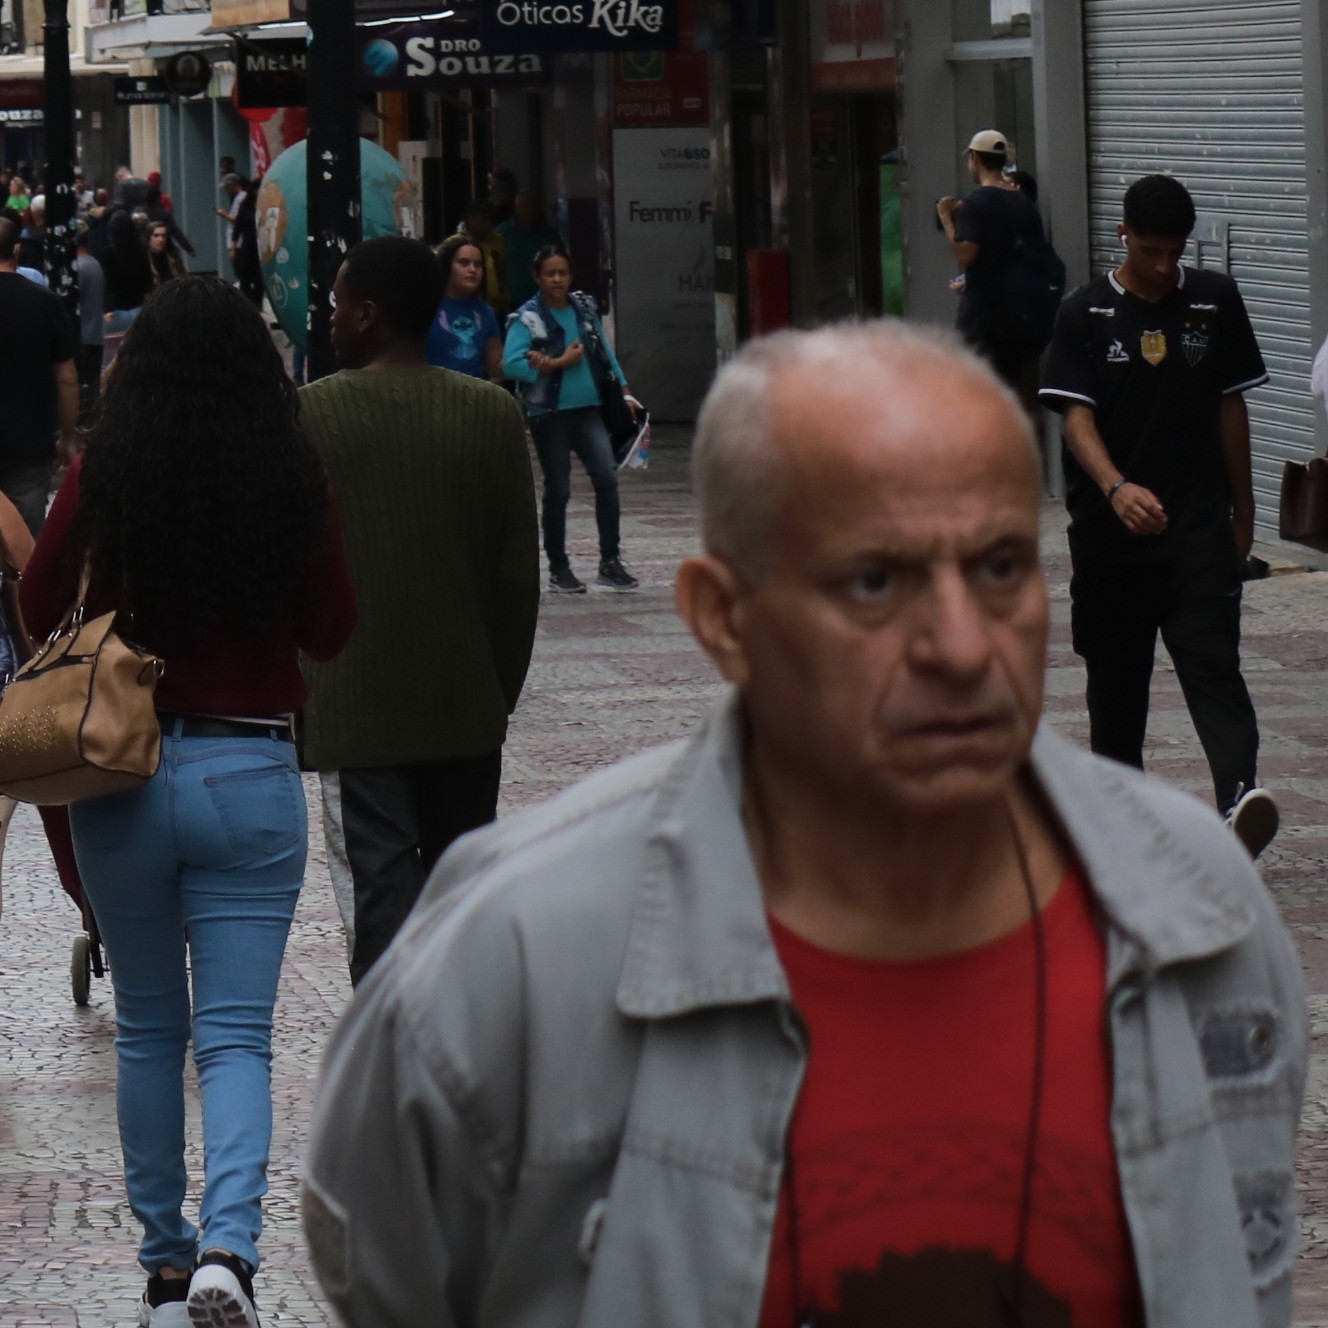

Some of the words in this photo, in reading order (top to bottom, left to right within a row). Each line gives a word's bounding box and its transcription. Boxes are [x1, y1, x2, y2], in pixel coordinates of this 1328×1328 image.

[440, 38, 481, 53] DRO
[406, 37, 543, 78] Souza
[616, 102, 672, 116] POPULAR
